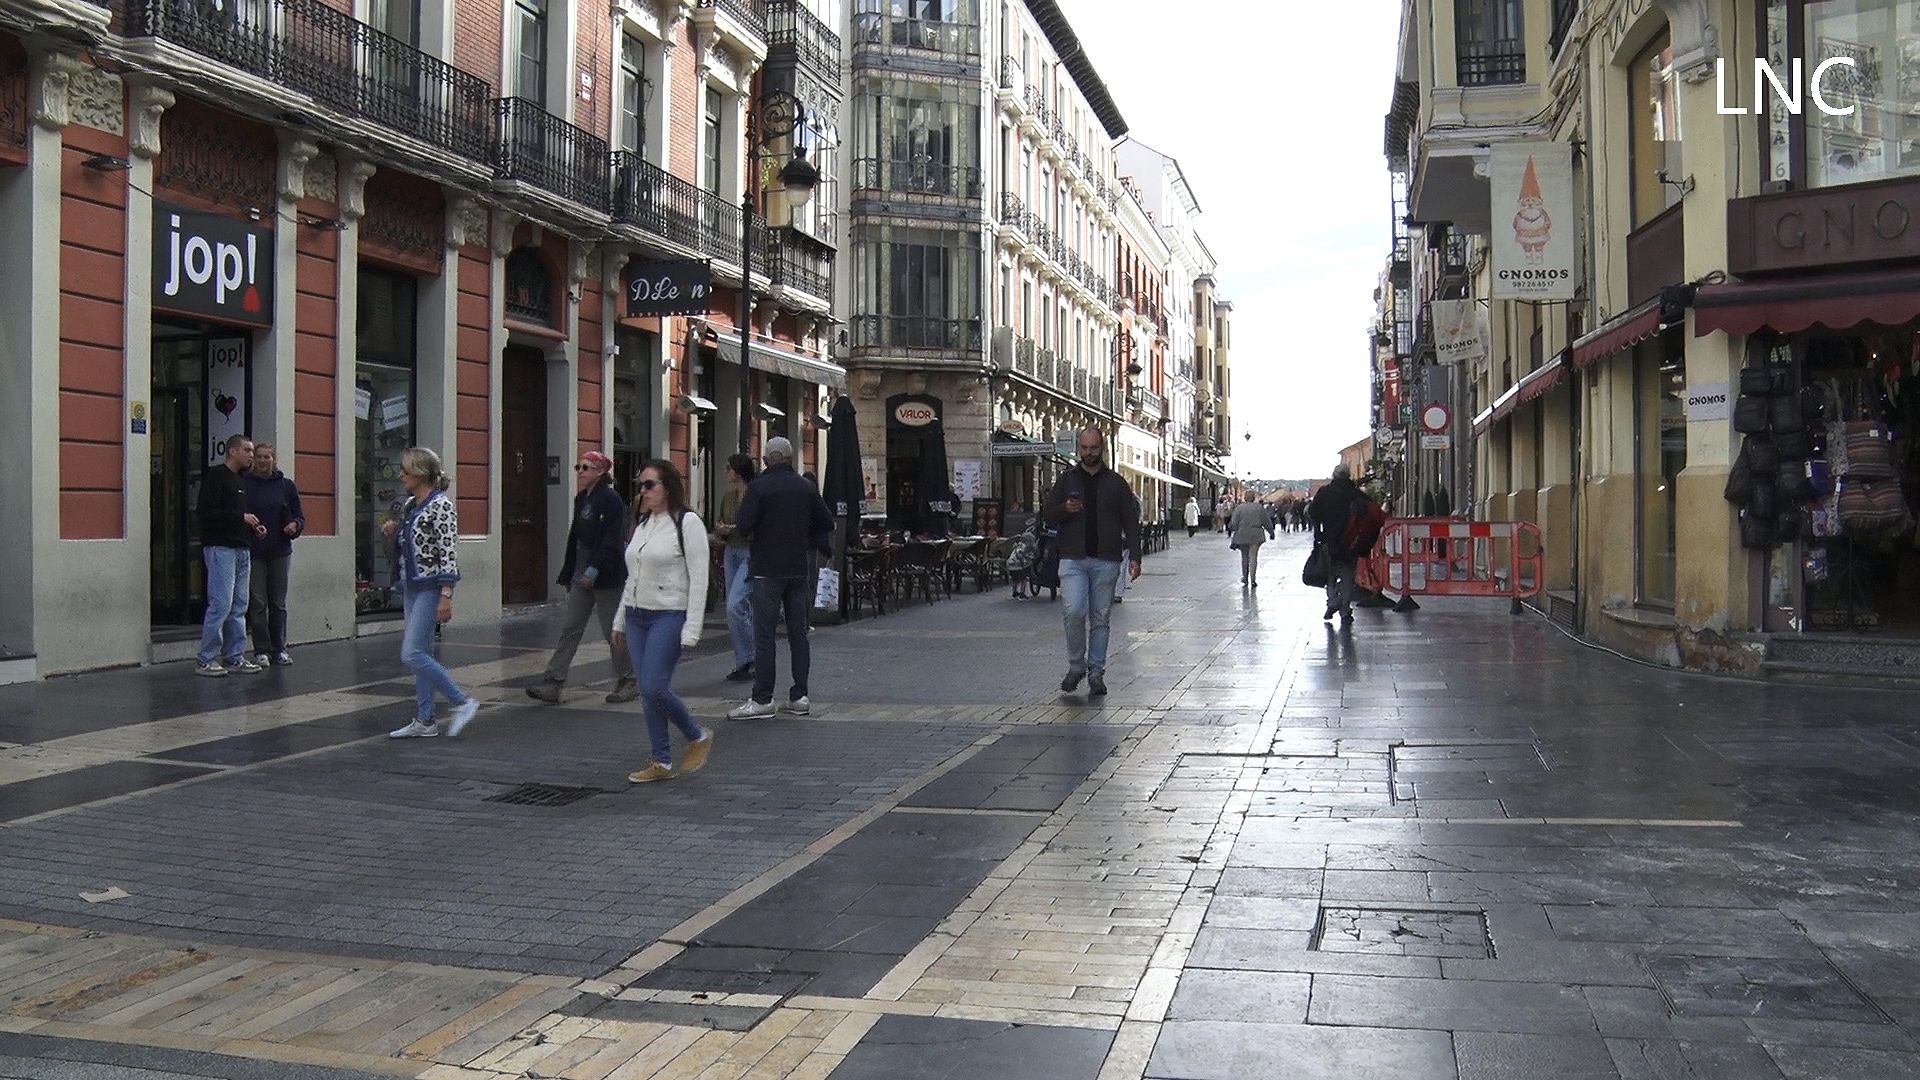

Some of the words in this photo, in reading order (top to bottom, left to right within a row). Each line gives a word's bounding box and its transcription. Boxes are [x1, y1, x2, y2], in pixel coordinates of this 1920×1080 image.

[164, 213, 262, 313] jop!
[1499, 269, 1569, 280] GNOMOS
[1439, 337, 1478, 351] GNOMOS
[210, 344, 246, 368] jop!
[1688, 394, 1726, 406] GNOMOS
[899, 409, 932, 419] VALOR
